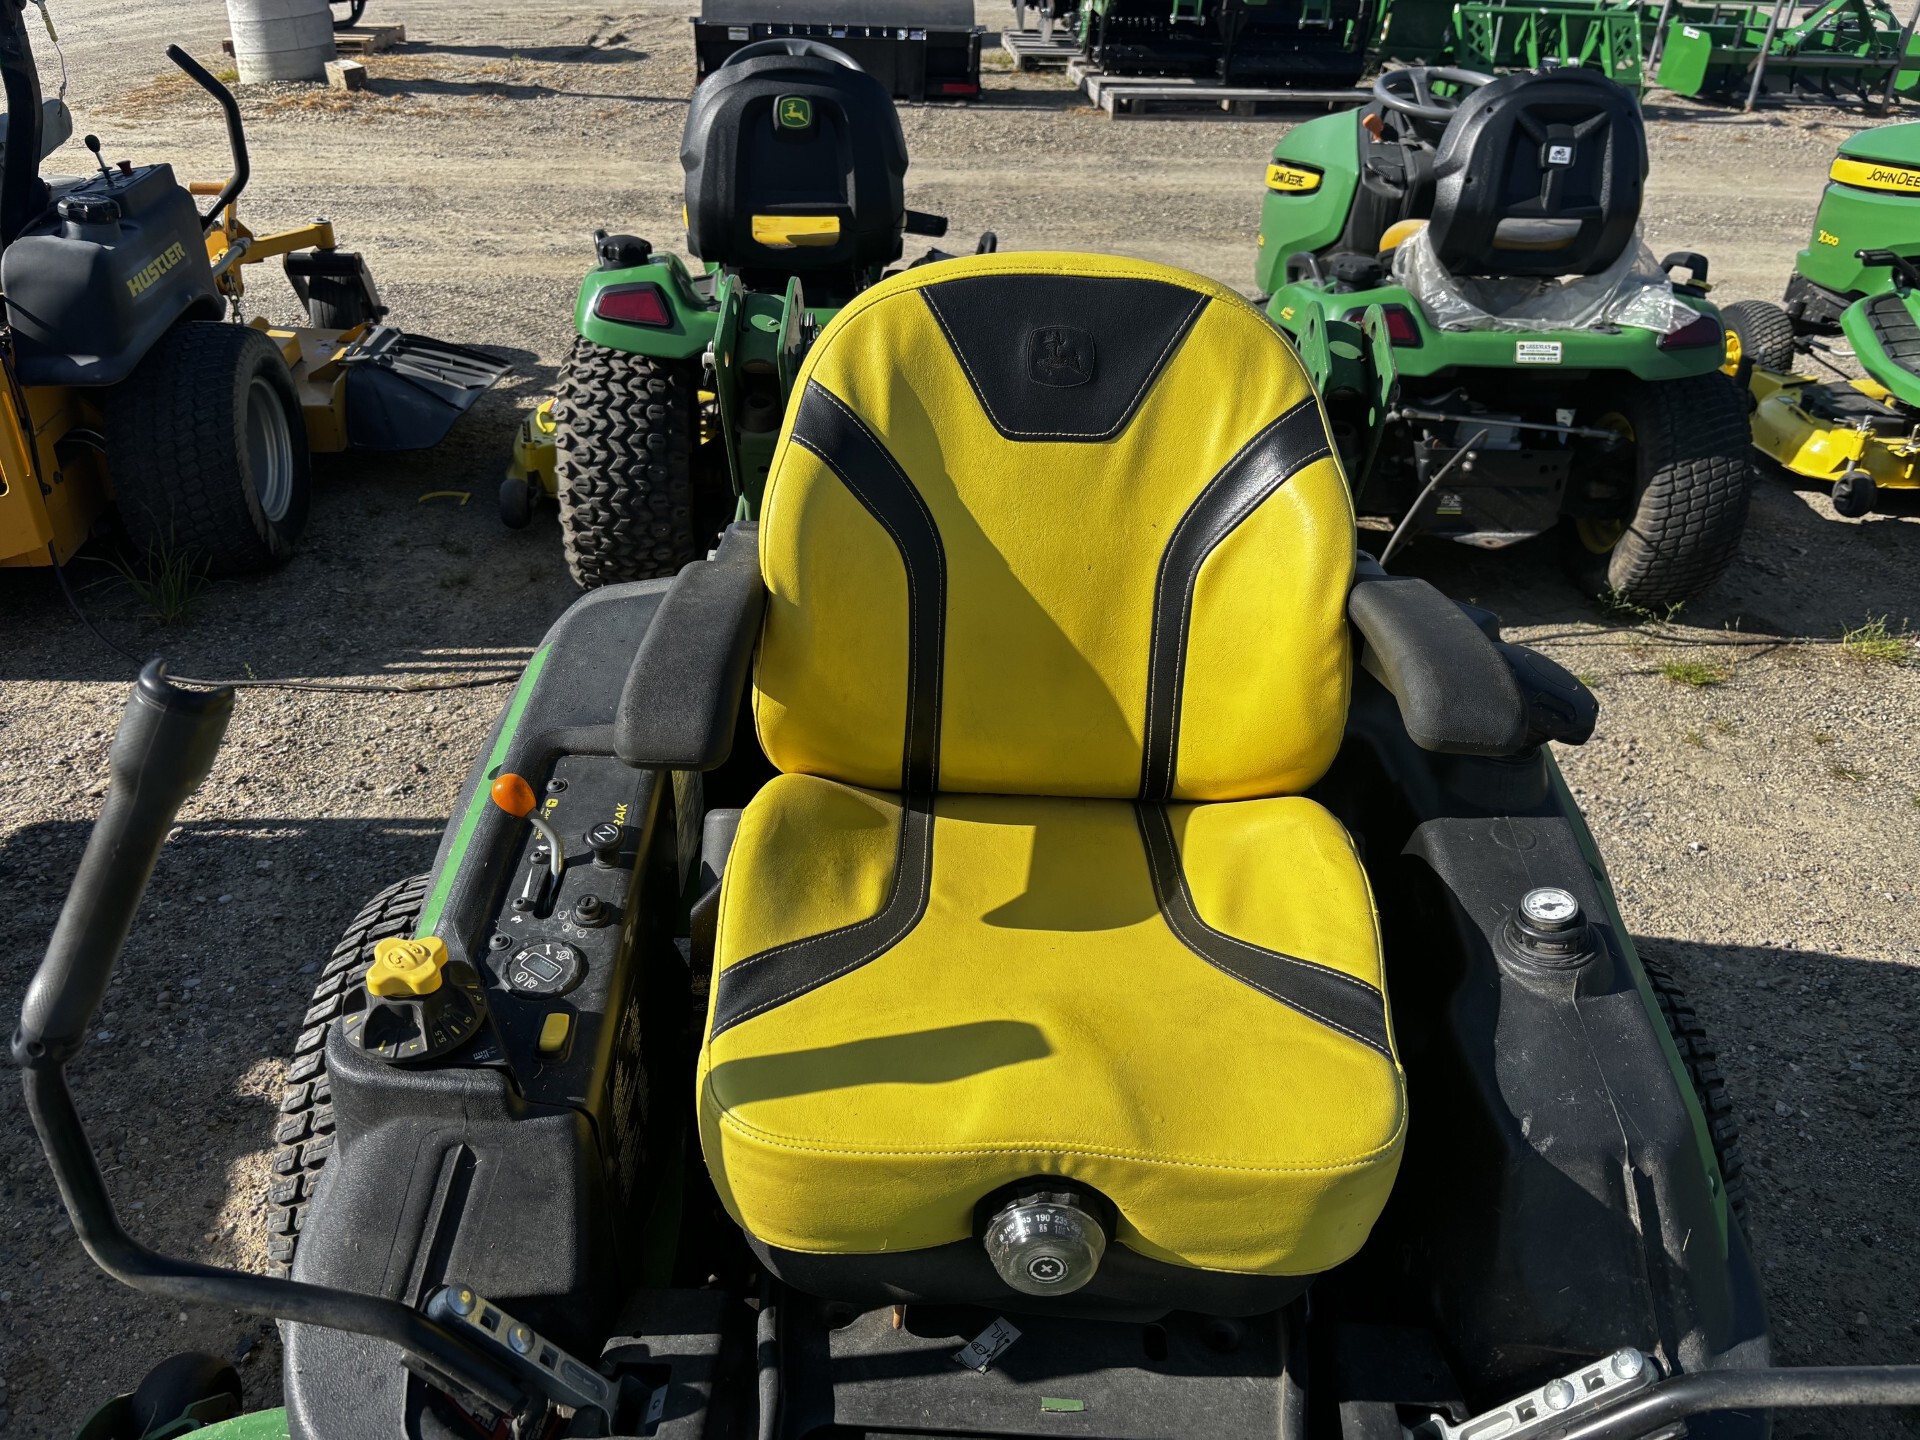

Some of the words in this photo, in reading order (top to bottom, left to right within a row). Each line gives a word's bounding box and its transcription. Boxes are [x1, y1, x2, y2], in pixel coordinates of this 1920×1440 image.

[1867, 168, 1899, 184] JOHN
[126, 241, 186, 298] HUSTLER
[1035, 1214, 1051, 1222] 190
[1038, 1223, 1048, 1233] 85
